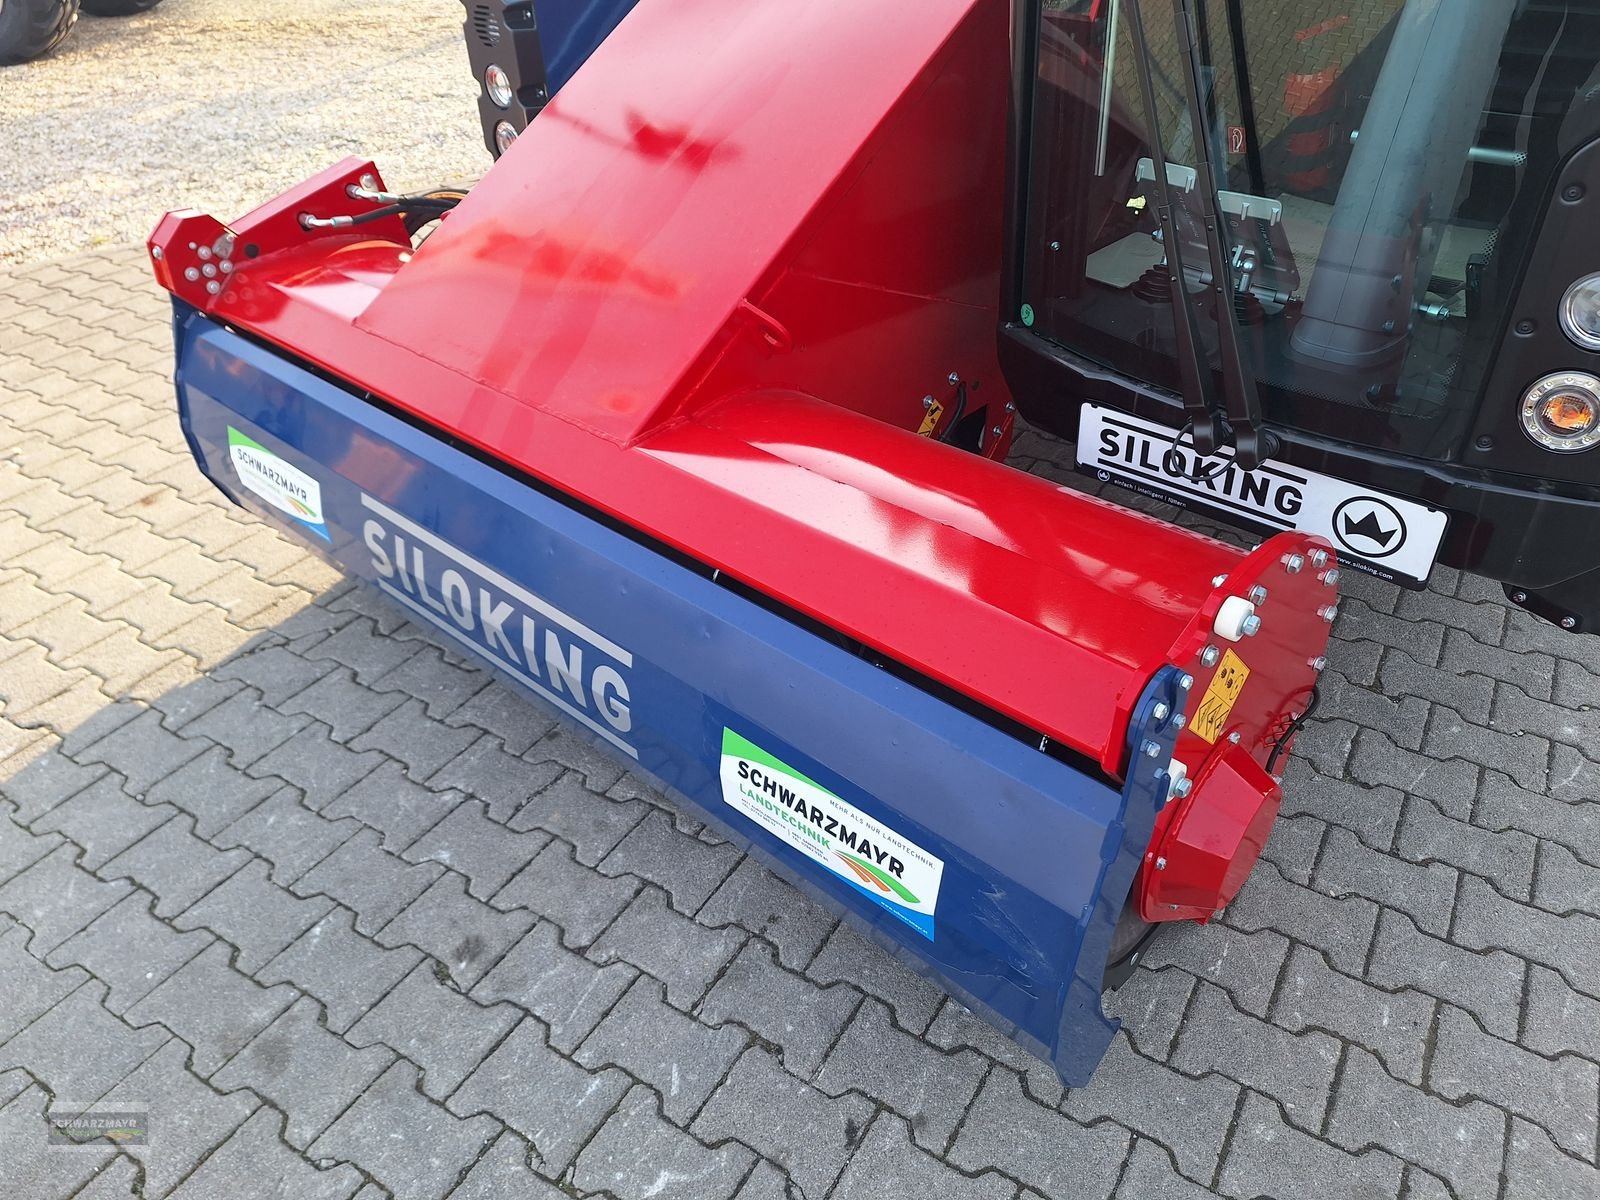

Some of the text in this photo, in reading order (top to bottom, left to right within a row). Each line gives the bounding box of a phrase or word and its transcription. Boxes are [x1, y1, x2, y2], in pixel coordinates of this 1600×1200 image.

[237, 447, 308, 503] SCHWARZMAYR
[1098, 428, 1303, 516] SILOKING
[1113, 478, 1133, 490] einfach
[364, 519, 632, 732] SILOKING
[737, 760, 905, 880] SCHWARZMAYR
[739, 782, 831, 850] LANDTECHNIK
[829, 799, 848, 815] MEHR
[850, 812, 864, 825] ALS
[866, 822, 881, 835] NUR
